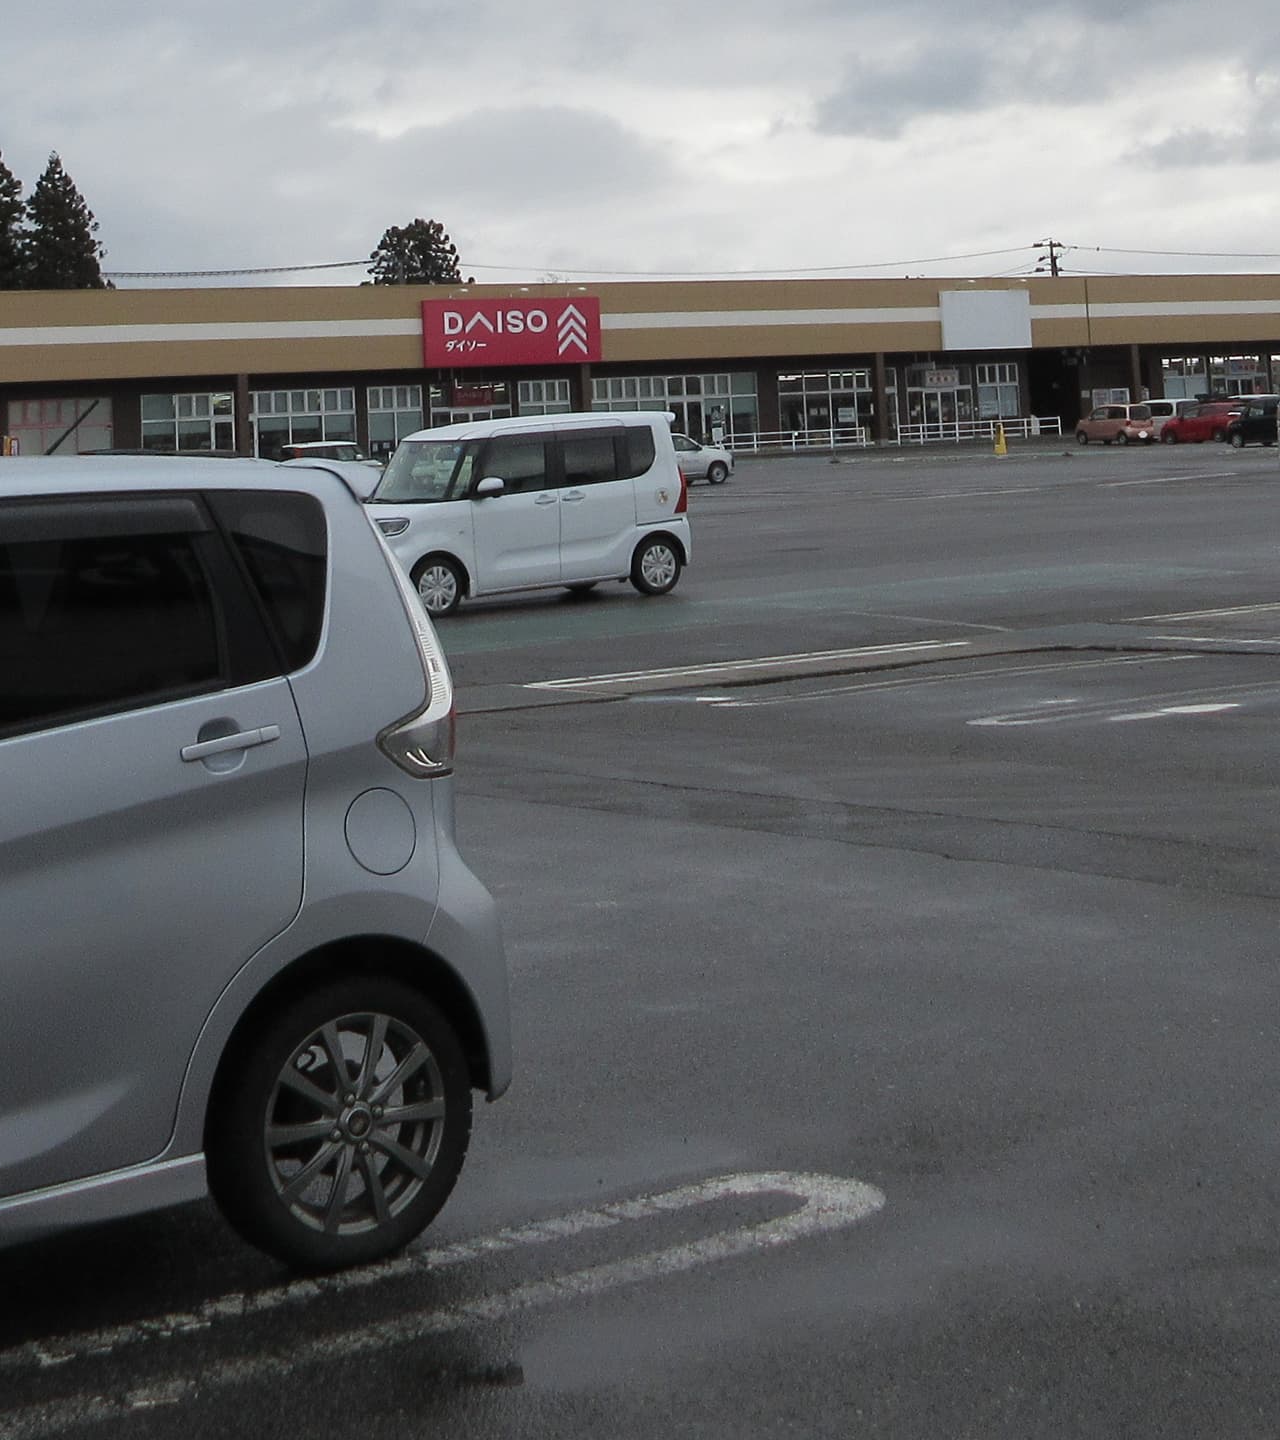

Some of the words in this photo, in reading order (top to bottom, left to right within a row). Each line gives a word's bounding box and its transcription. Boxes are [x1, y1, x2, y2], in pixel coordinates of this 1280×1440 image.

[443, 310, 549, 335] DAISO
[445, 339, 487, 352] ダイソー
